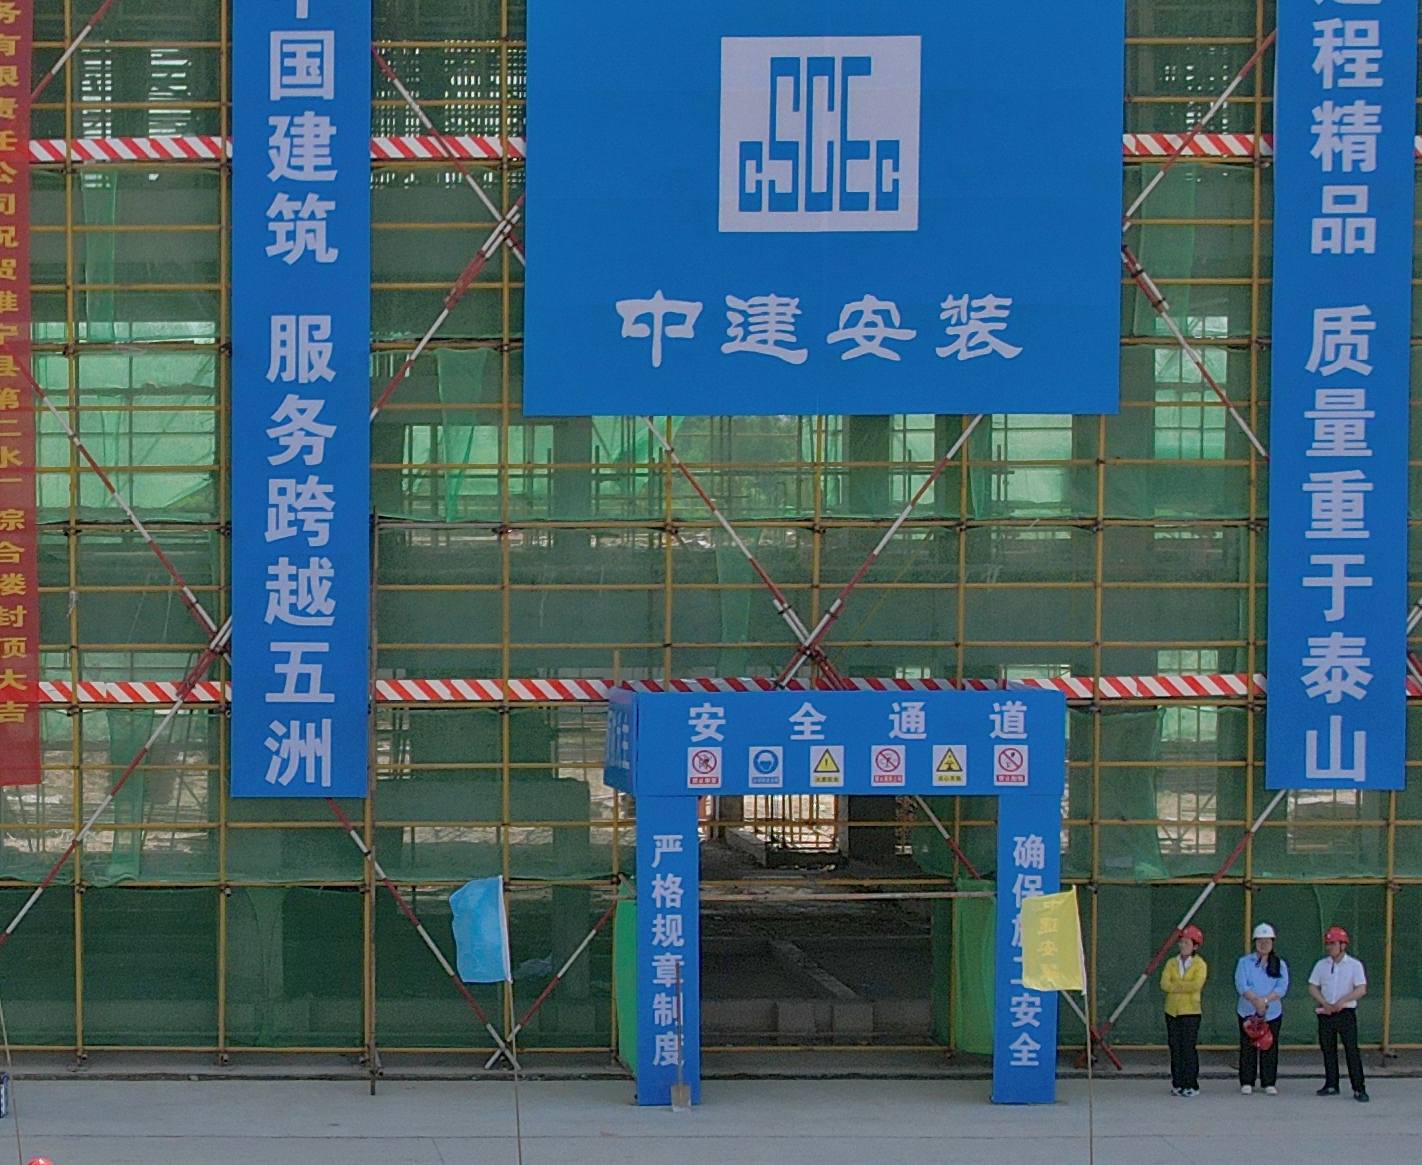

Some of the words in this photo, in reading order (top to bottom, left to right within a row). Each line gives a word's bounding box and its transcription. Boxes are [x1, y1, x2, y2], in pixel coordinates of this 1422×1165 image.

[739, 57, 900, 212] CSCEC
[615, 289, 1023, 367] 中建安装
[264, 314, 337, 788] 服务跨越五洲
[1301, 304, 1377, 783] 质量重于泰山
[688, 701, 1028, 741] 安全通道
[652, 834, 685, 1067] 严格规章制度
